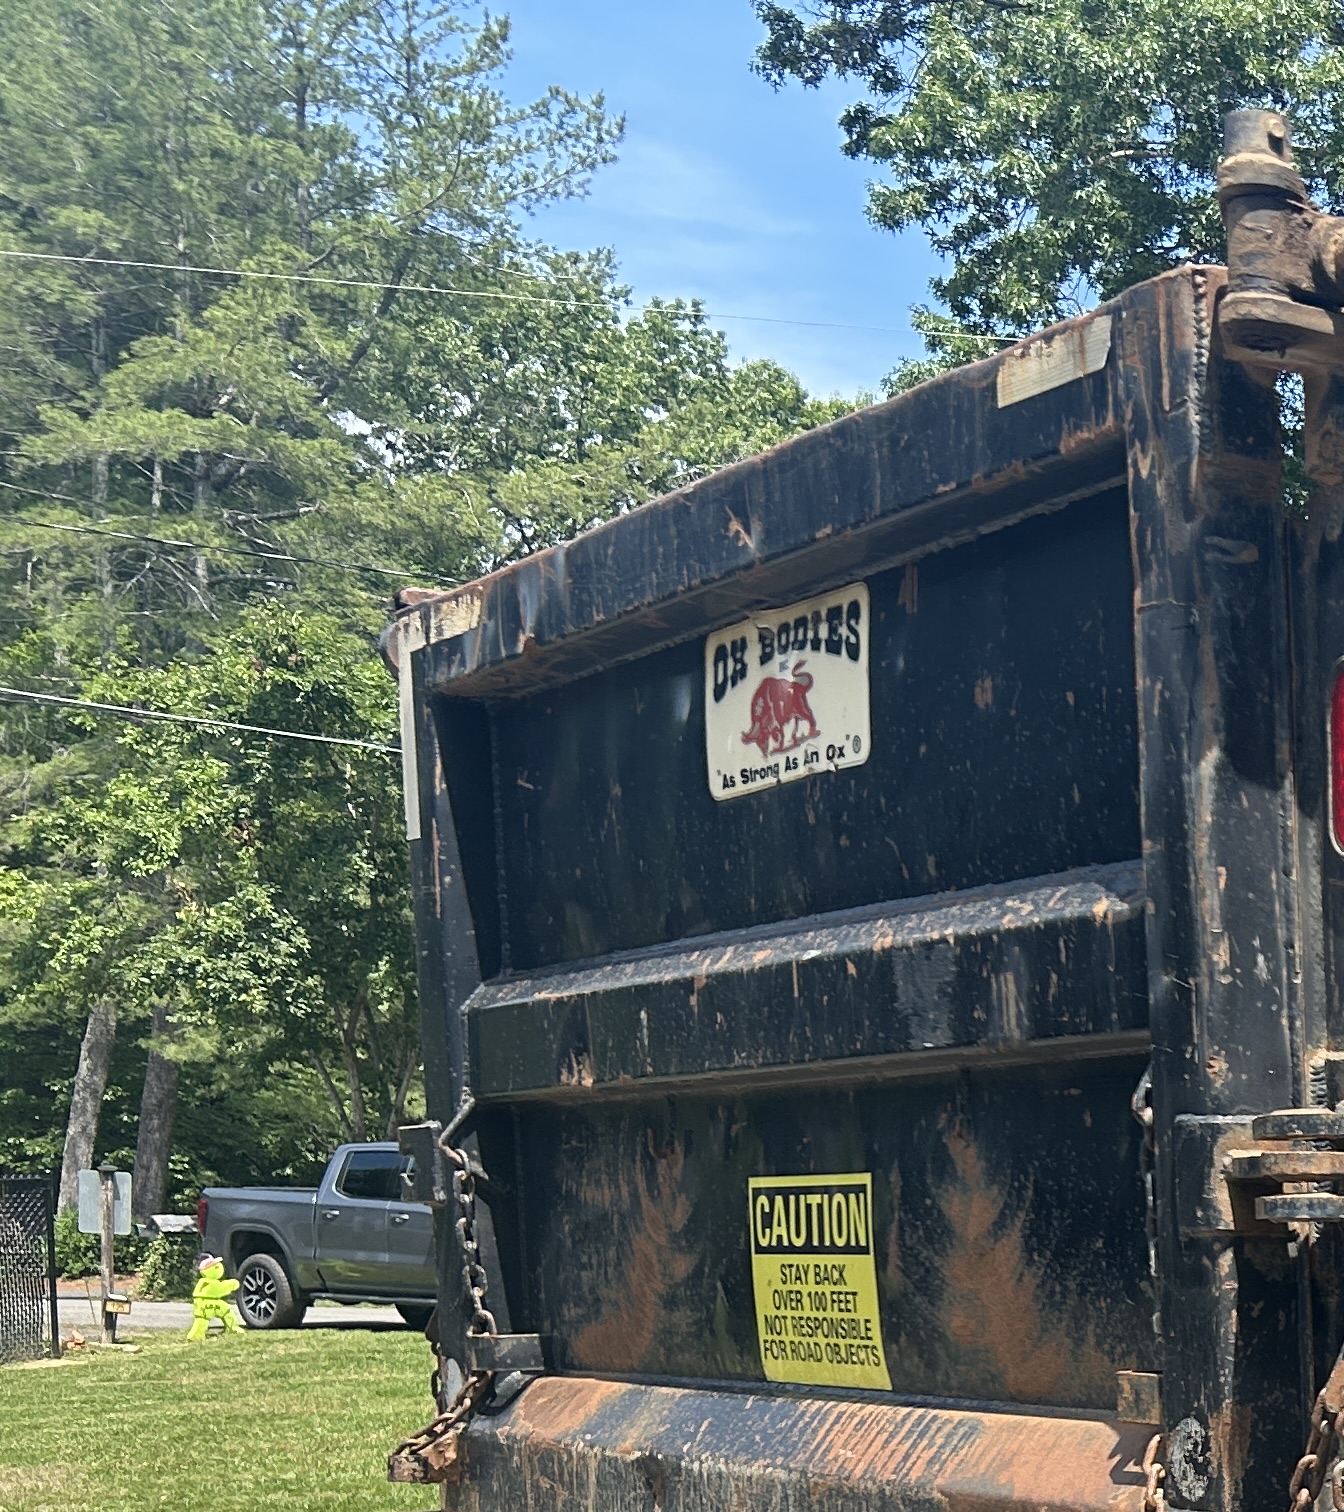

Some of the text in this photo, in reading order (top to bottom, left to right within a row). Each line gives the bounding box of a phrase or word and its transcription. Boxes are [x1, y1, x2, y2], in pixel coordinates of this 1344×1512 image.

[713, 600, 861, 703] OX BODIES
[740, 762, 780, 785] Strong
[784, 755, 799, 772] As
[803, 747, 819, 767] An
[755, 1193, 867, 1248] CAUTION
[780, 1264, 847, 1287] STAY BACK
[772, 1290, 858, 1313] OVER 100 FEET
[764, 1315, 873, 1341] NOT RESPONSIBLE
[763, 1339, 881, 1367] FOR ROAD OBJECTS
